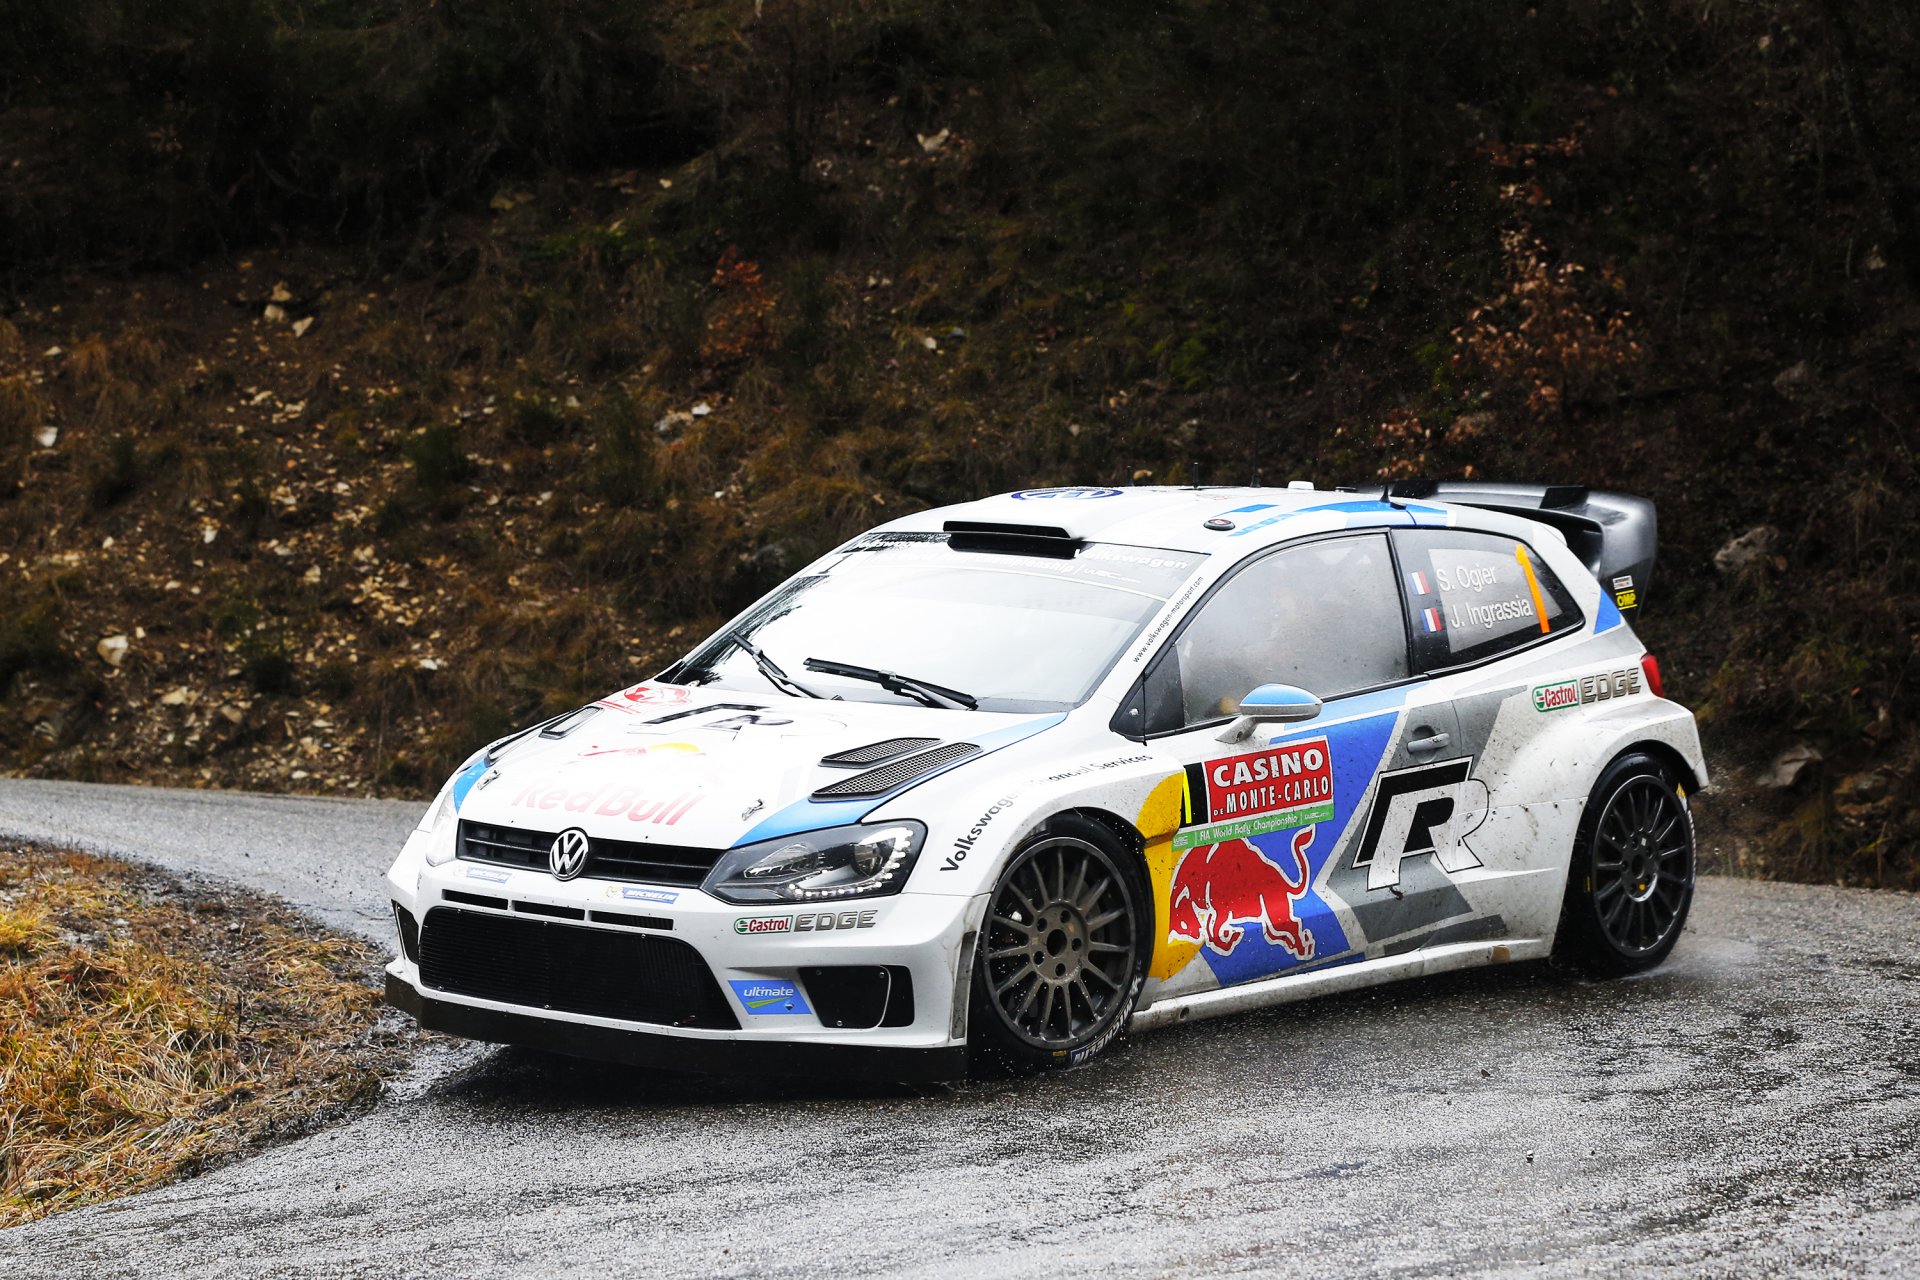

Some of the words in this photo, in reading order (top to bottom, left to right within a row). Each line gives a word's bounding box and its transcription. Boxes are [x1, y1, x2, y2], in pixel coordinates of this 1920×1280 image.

[1437, 568, 1455, 592] S.
[1456, 563, 1497, 592] Ogier
[1133, 576, 1204, 663] www.volkswagen-motorsport.com
[1450, 604, 1465, 628] J.
[1466, 594, 1534, 629] Ingrassia
[1544, 683, 1578, 708] Castrol
[1580, 667, 1641, 704] EDGE
[1090, 753, 1155, 772] Services
[1213, 748, 1324, 788] CASINO
[1213, 807, 1225, 816] DE
[1226, 775, 1329, 814] MONTE-CARLO
[1199, 829, 1211, 842] FIA
[1213, 826, 1233, 840] World
[1253, 813, 1298, 832] Championship
[1351, 755, 1489, 891] R
[748, 917, 789, 932] Castrol
[794, 909, 879, 932] EDGE
[743, 986, 794, 997] ultimate
